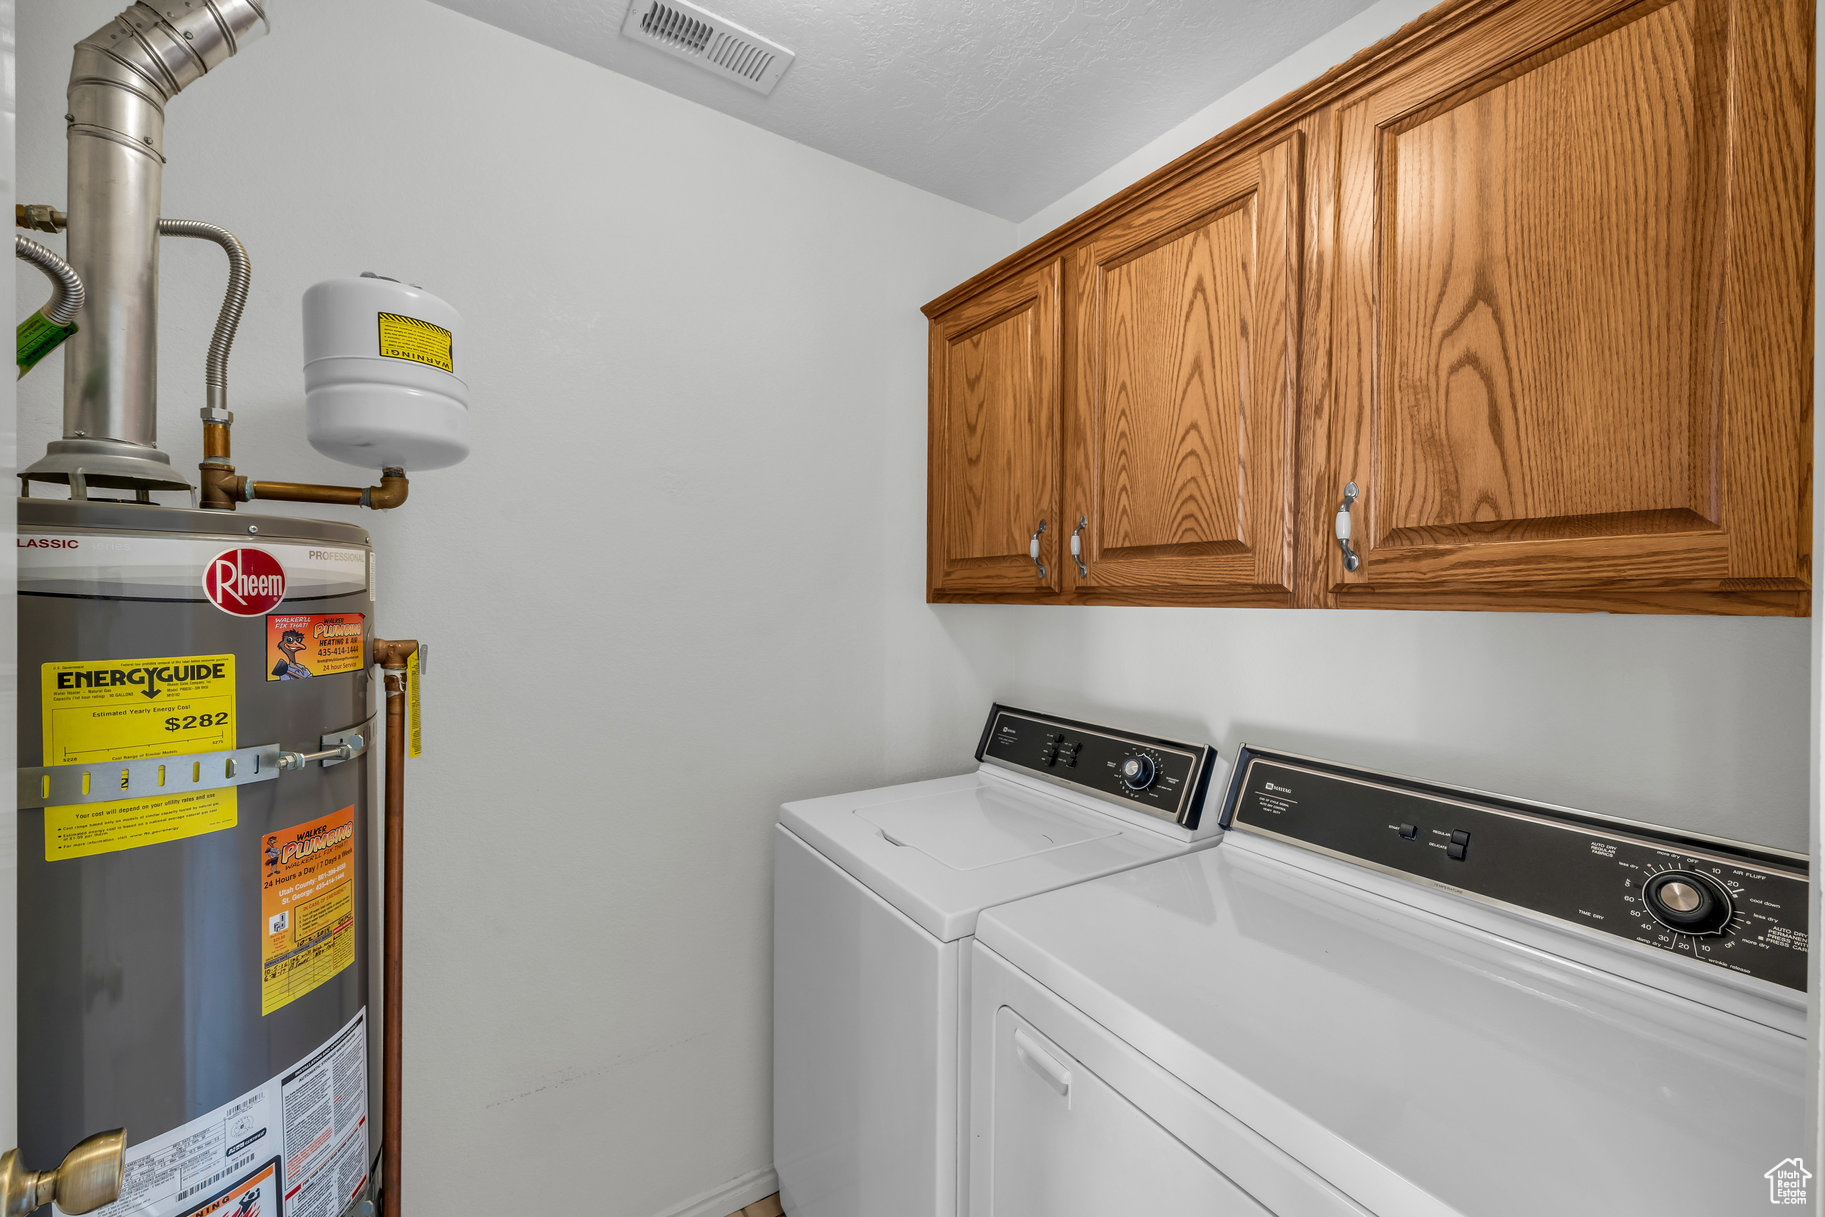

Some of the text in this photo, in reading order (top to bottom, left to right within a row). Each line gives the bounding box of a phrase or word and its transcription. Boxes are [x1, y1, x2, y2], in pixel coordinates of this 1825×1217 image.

[386, 349, 450, 369] WARNING!
[17, 538, 79, 549] LASSIC
[309, 550, 364, 562] PROFESSIONAL
[216, 550, 282, 606] Rheem
[313, 622, 361, 638] PLUMBING
[320, 638, 344, 646] HEATING
[318, 645, 358, 657] 435-414-1444
[57, 663, 226, 696] ENERGYGUIDE
[164, 712, 228, 732] $282
[119, 806, 140, 814] depend
[296, 825, 327, 841] WALKER
[281, 821, 352, 864] PLUMBING
[1590, 846, 1616, 854] REGULAR
[1592, 849, 1613, 857] FABRICS
[264, 880, 273, 889] 24
[275, 873, 296, 885] Hours
[304, 866, 315, 874] Day
[325, 857, 337, 866] Days
[279, 878, 317, 897] Utah County:
[292, 888, 314, 900] George:
[1767, 934, 1791, 944] PRESS
[1768, 929, 1808, 942] PERMANEN
[1724, 940, 1736, 949] OFF
[1766, 938, 1790, 948] PRESS
[1708, 958, 1750, 974] wrinkle release
